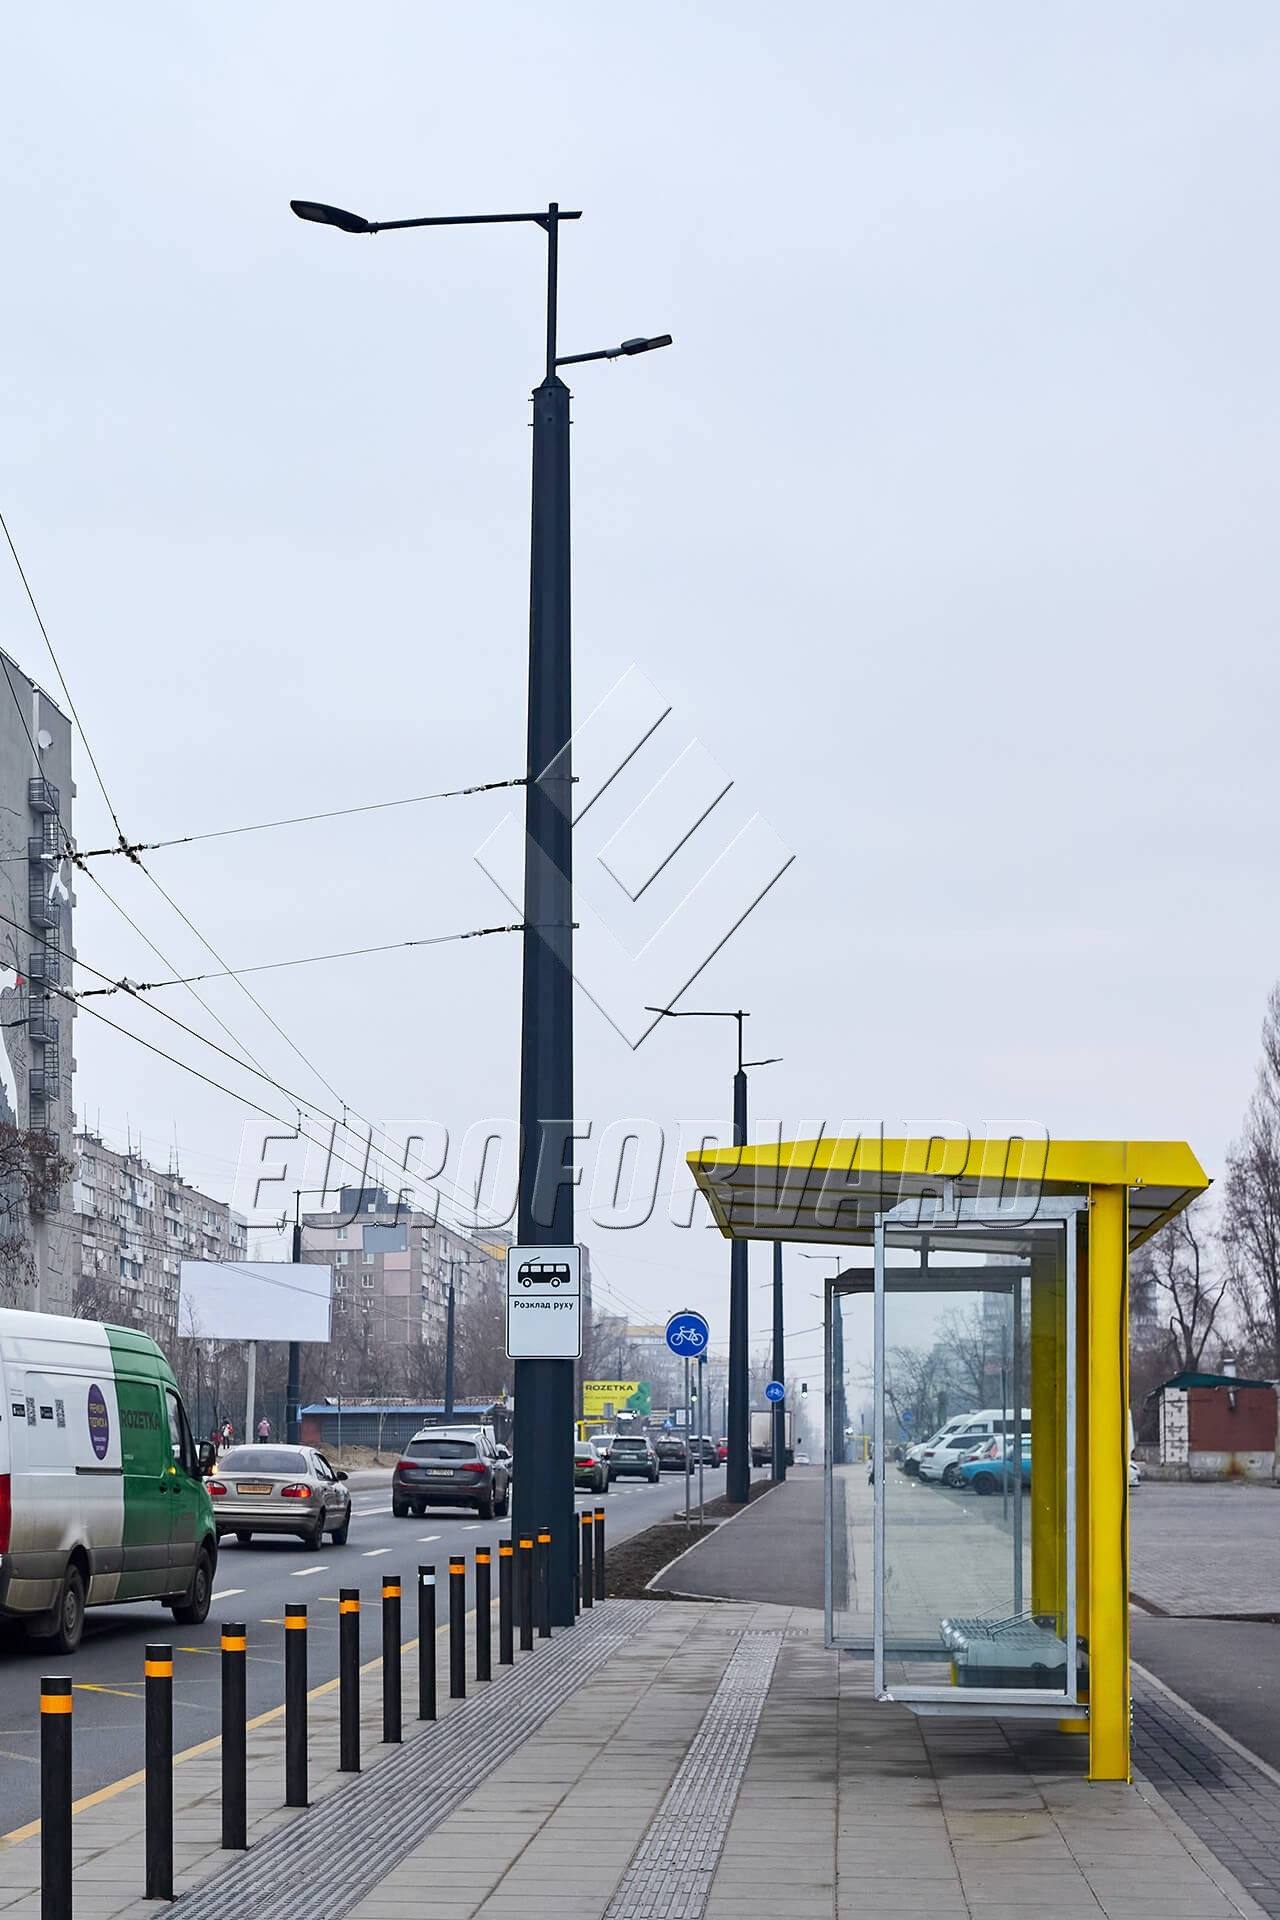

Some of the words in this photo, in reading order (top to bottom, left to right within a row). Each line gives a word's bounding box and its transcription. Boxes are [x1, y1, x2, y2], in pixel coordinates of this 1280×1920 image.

[513, 1300, 551, 1310] Розклад
[553, 1302, 574, 1310] руху
[585, 1384, 634, 1392] ROZETKA
[120, 1408, 161, 1431] ROZETKA
